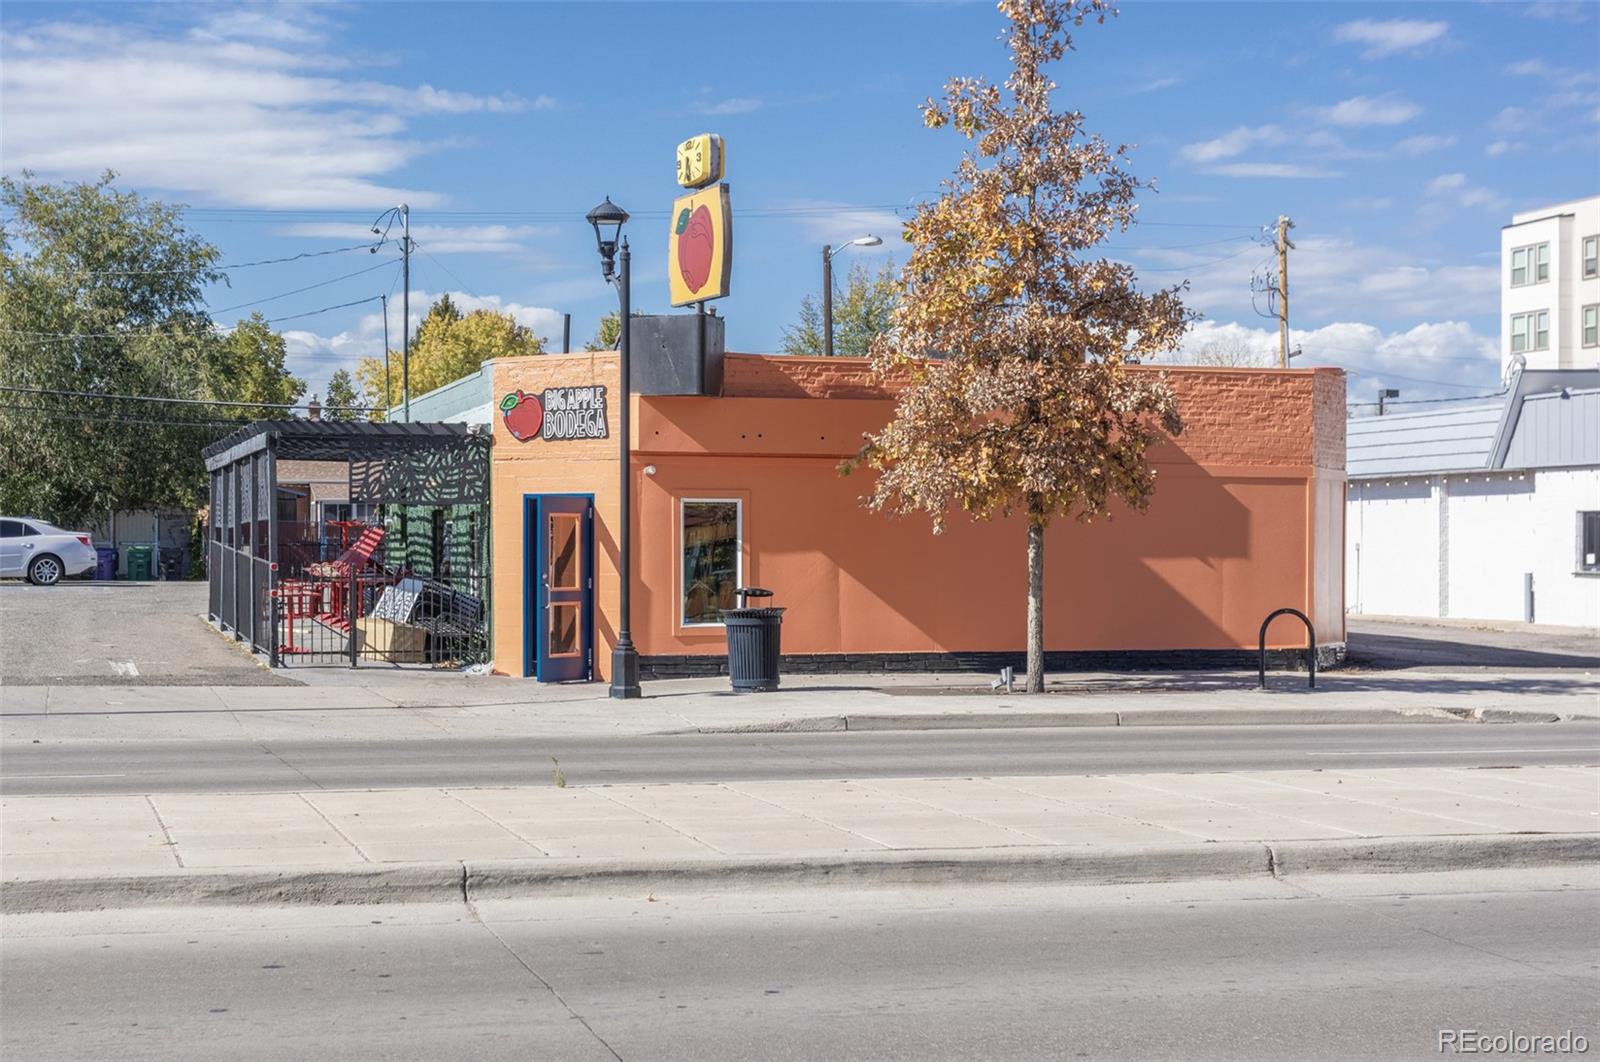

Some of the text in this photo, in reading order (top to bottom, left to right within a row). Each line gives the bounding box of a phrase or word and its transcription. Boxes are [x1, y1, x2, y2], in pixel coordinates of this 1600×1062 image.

[696, 152, 702, 162] 3
[544, 387, 604, 411] BIG APPLE
[543, 409, 607, 439] BODEGA
